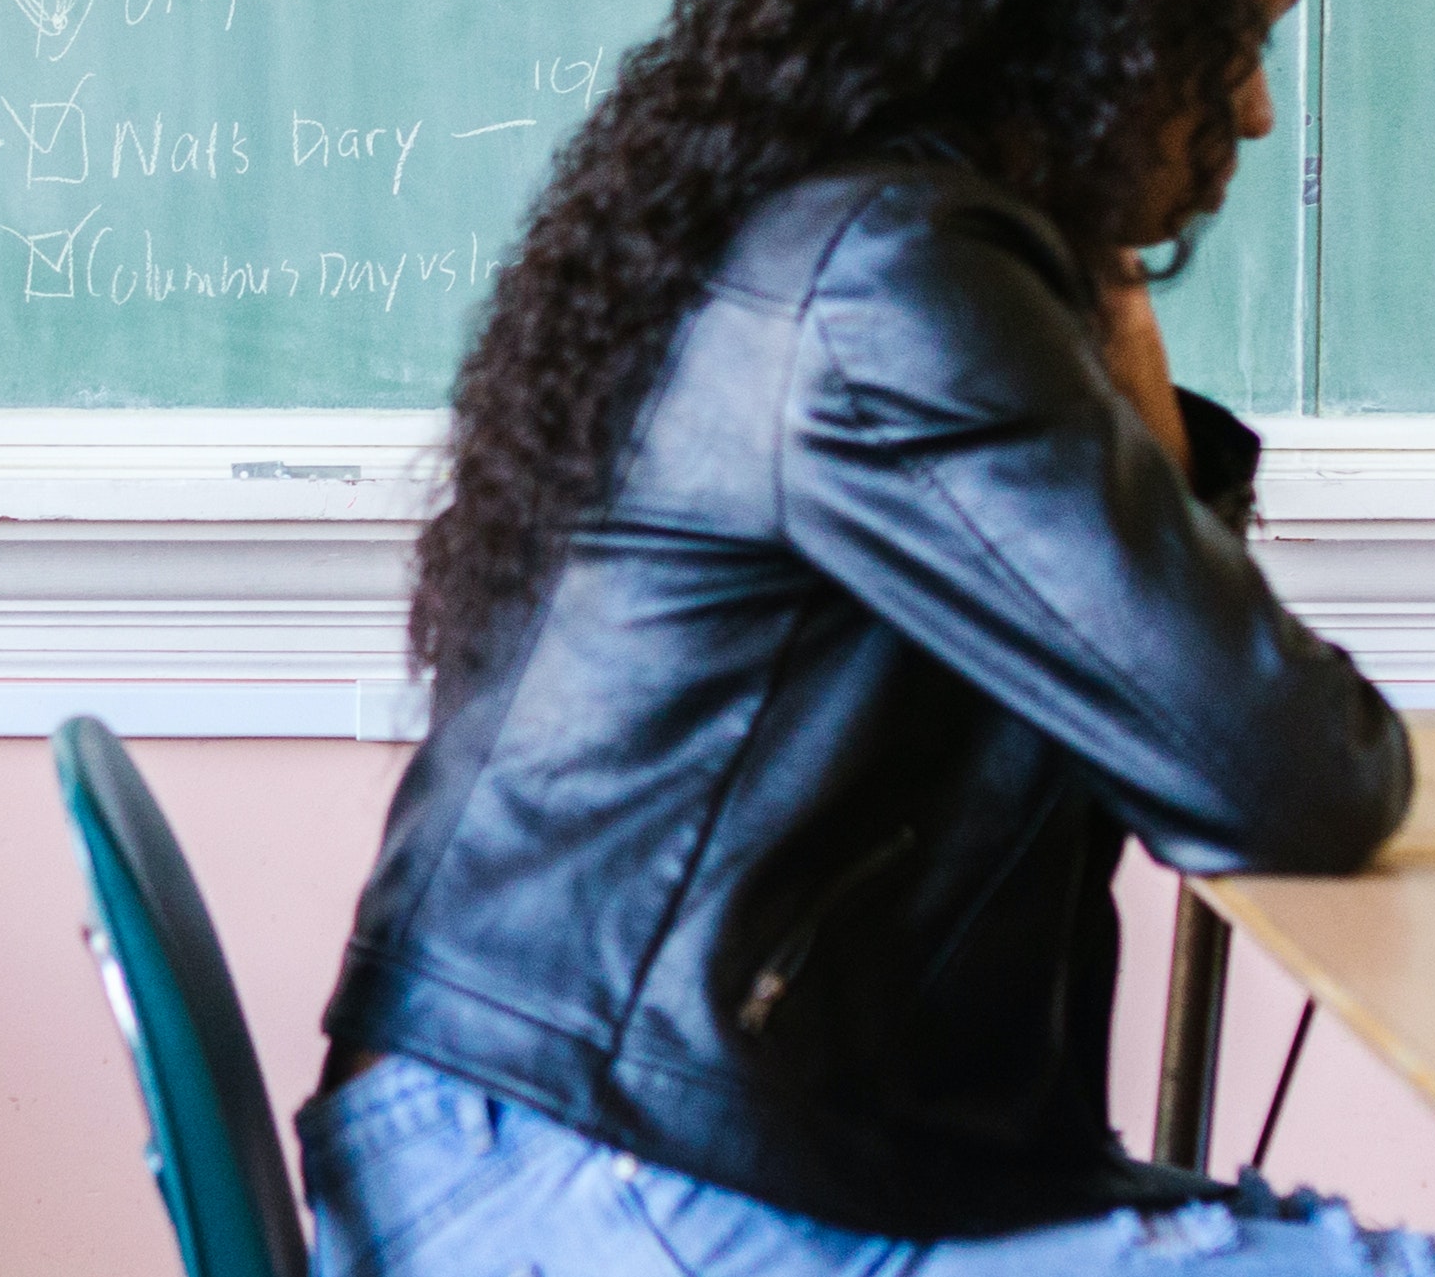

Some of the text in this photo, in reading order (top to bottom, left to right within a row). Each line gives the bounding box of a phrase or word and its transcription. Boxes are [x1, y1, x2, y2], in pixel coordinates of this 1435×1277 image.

[293, 111, 422, 194] Diary
[87, 227, 298, 306] Columbus
[320, 252, 407, 312] Day
